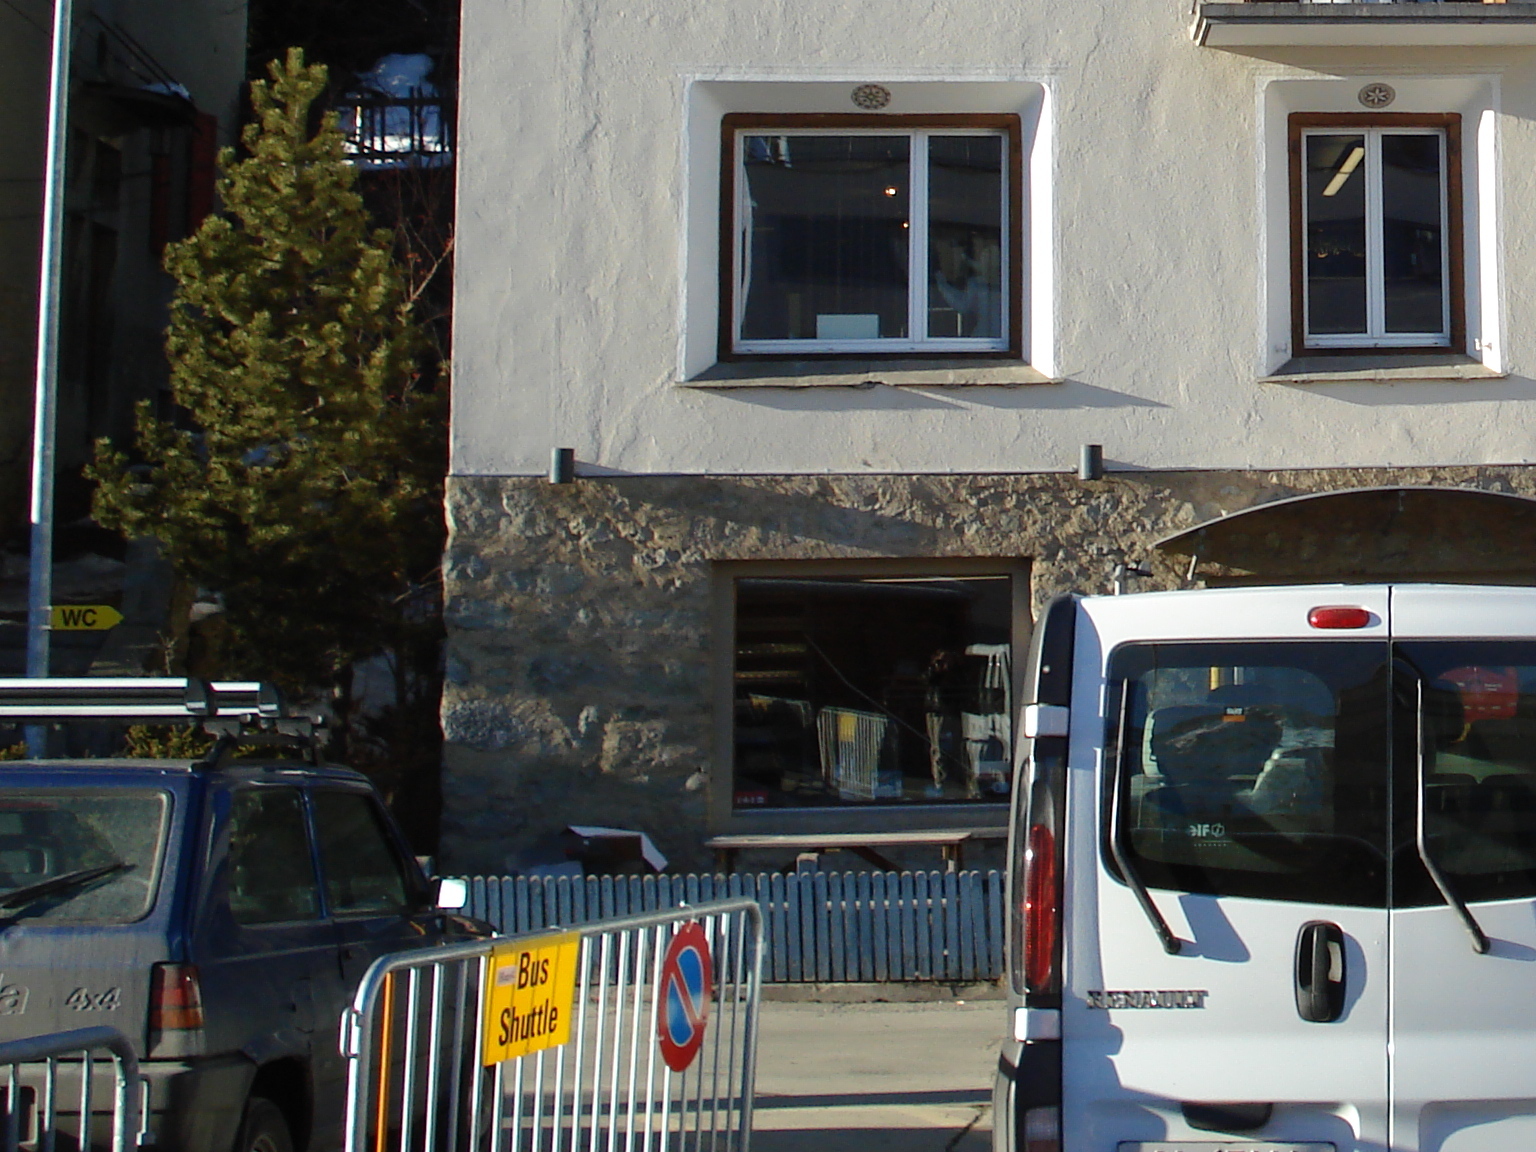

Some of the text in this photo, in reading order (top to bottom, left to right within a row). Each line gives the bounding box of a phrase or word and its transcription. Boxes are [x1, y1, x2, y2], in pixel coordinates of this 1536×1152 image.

[62, 609, 97, 626] WC
[517, 951, 549, 990] Bus
[65, 986, 121, 1011] 4x4
[1086, 990, 1209, 1009] RENAULT
[498, 999, 558, 1046] Shuttle
